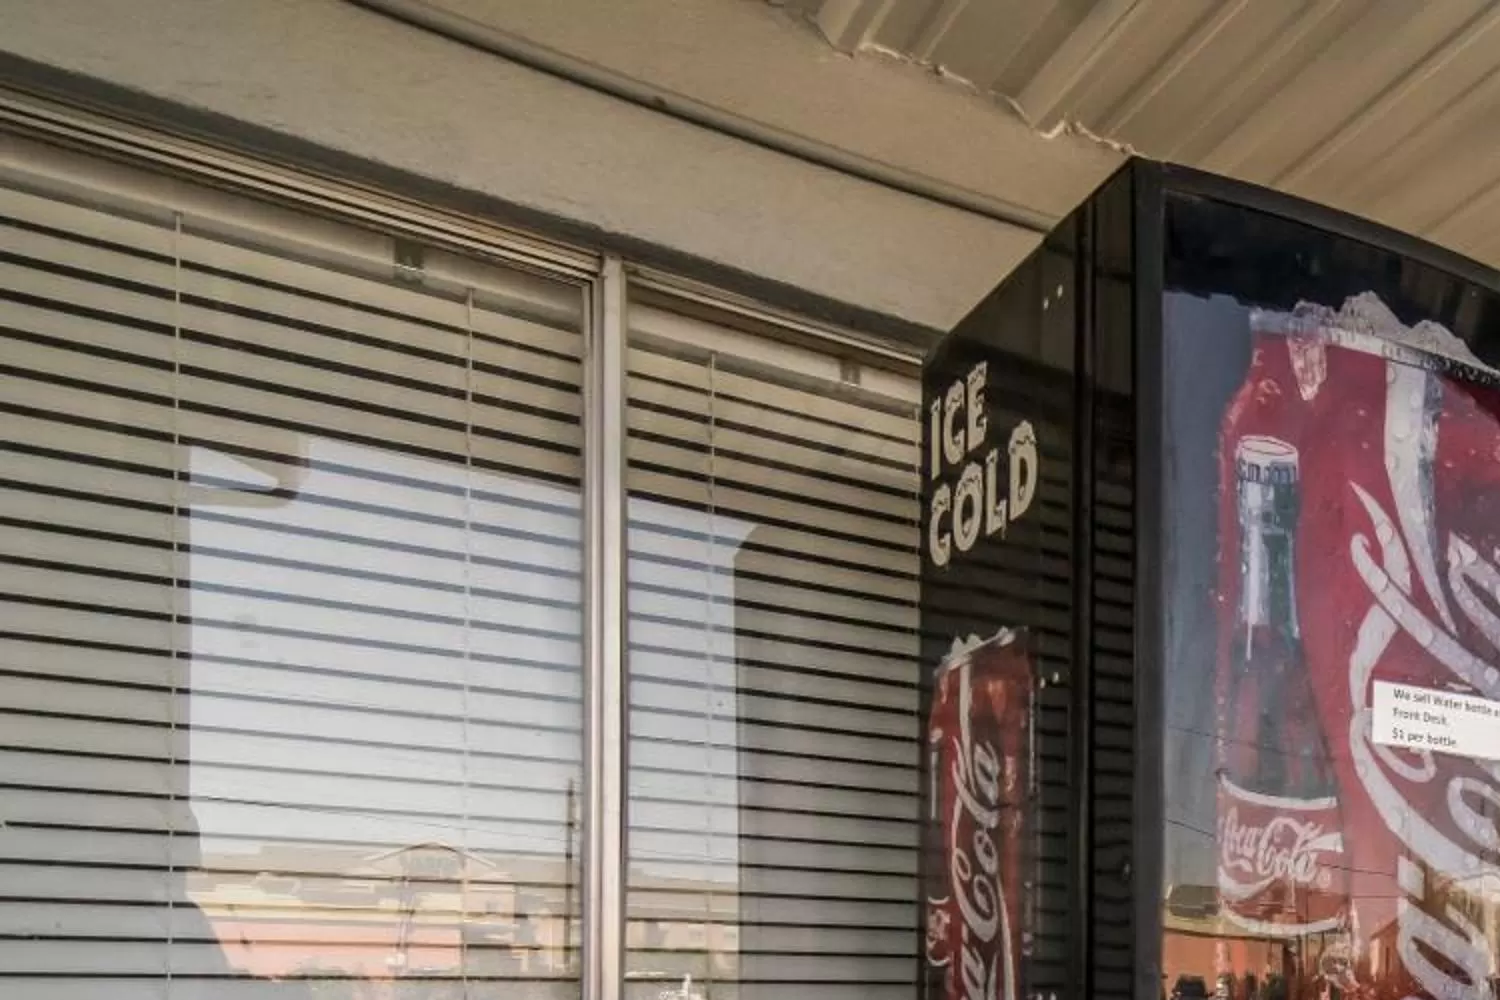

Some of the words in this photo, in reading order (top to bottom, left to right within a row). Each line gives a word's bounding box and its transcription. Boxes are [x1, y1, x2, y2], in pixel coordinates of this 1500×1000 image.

[930, 360, 988, 480] ICE
[929, 419, 1038, 567] COLD
[1393, 688, 1411, 700] We
[1413, 693, 1431, 704] sell
[1433, 697, 1462, 709] Water
[1465, 701, 1492, 713] bottle
[1392, 707, 1420, 720] Front
[1392, 727, 1404, 740] $1
[1407, 732, 1425, 743] per
